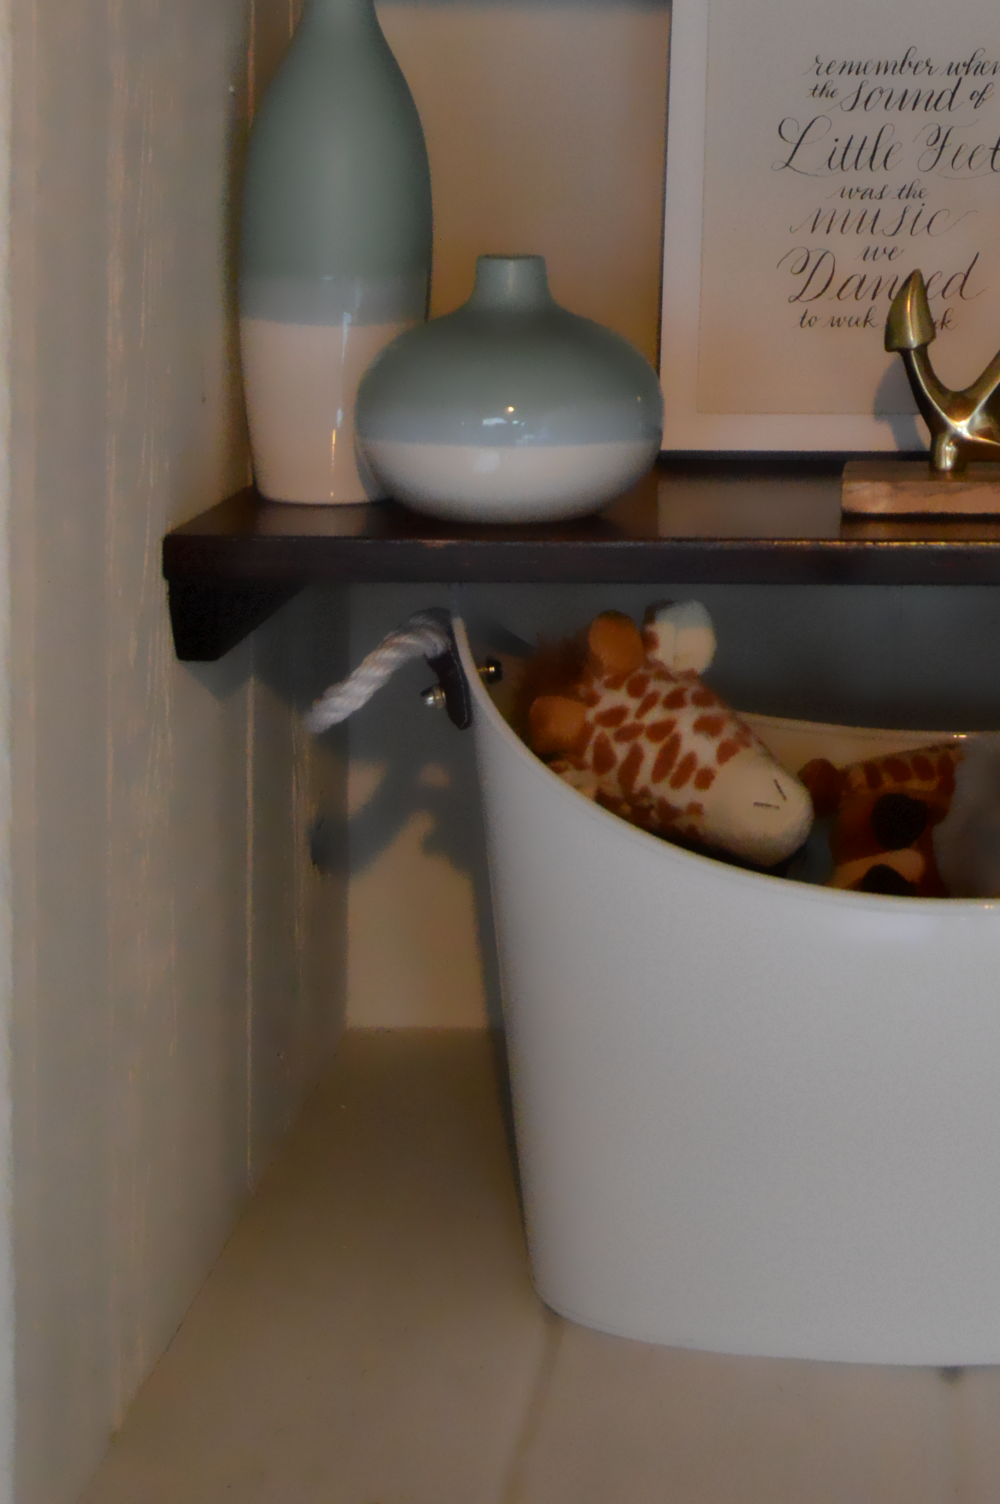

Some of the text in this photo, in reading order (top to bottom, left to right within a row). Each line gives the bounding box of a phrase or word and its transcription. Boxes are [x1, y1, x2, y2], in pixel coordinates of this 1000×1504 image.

[803, 46, 941, 76] remember
[809, 79, 839, 99] the
[970, 81, 995, 110] of
[771, 114, 903, 178] Little
[830, 178, 930, 200] was the
[789, 203, 978, 237] music
[858, 246, 905, 262] we
[799, 305, 880, 330] to week
